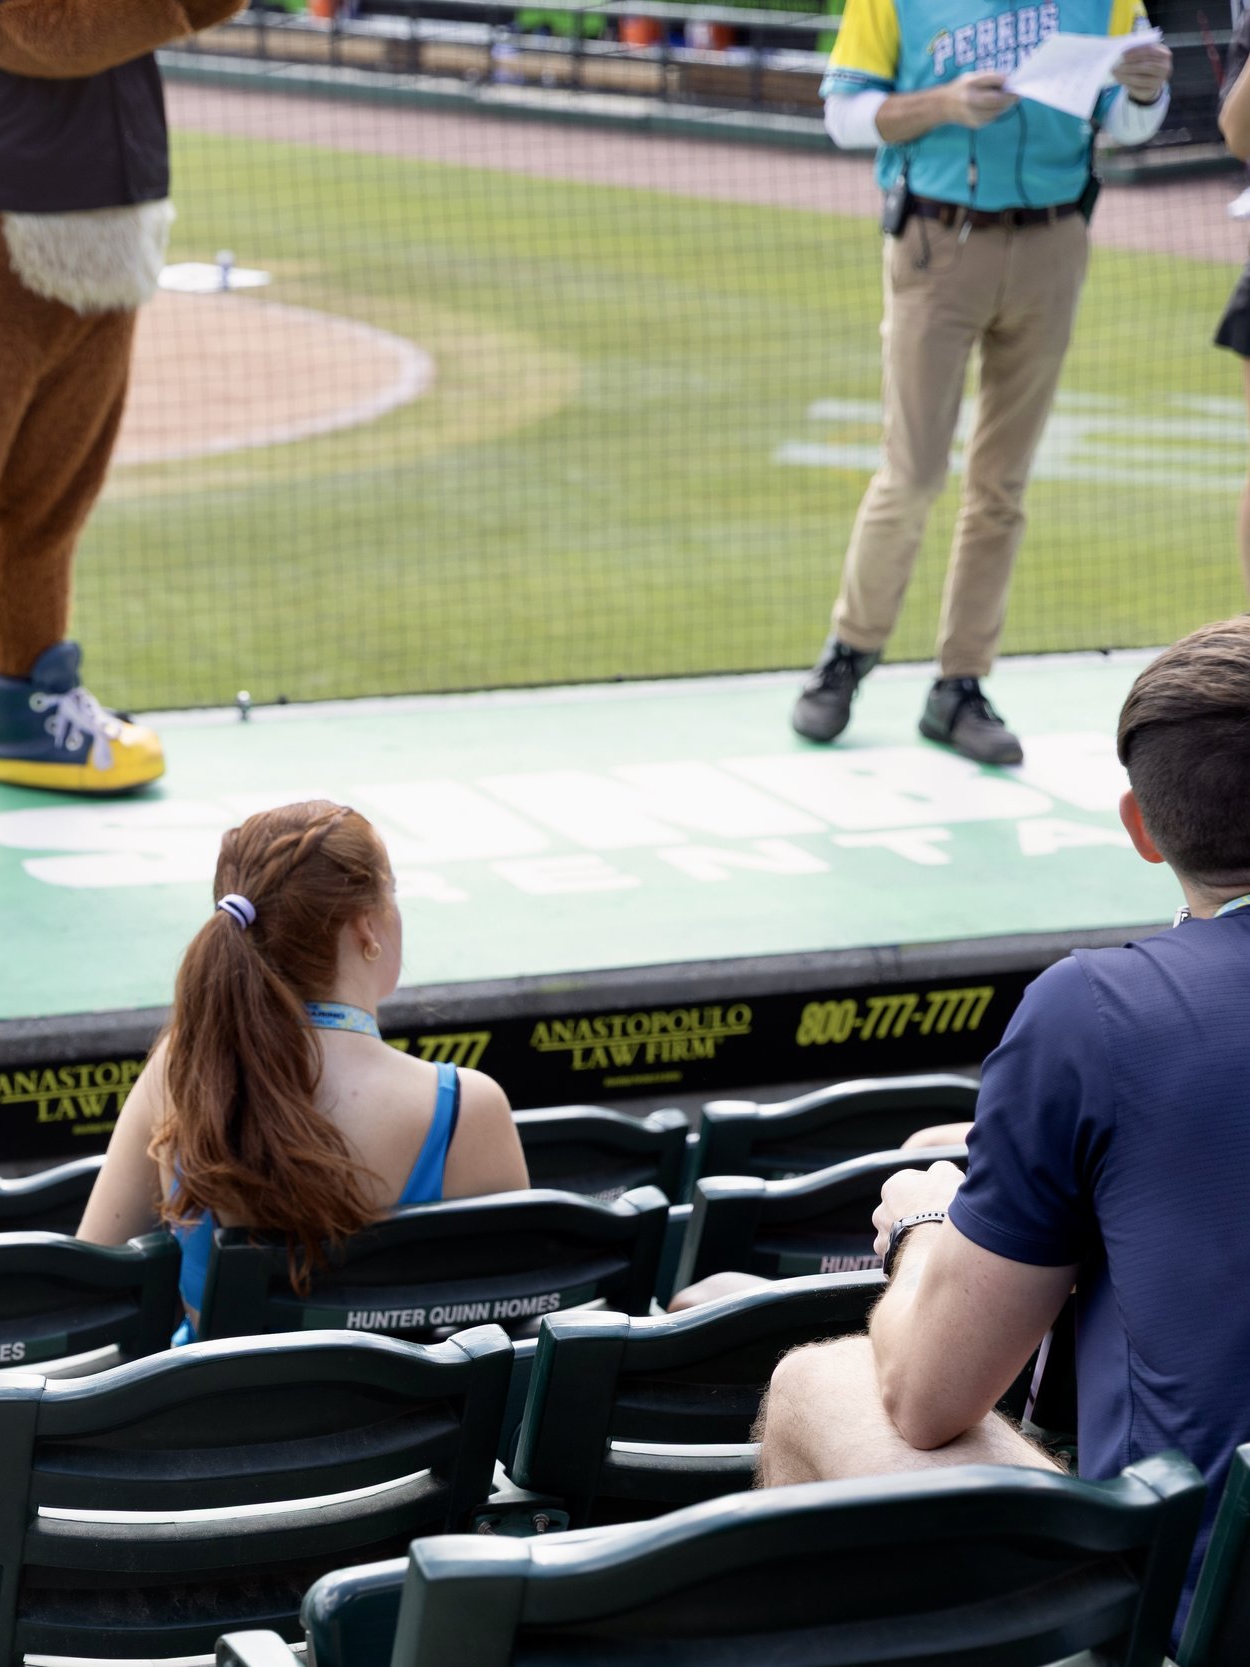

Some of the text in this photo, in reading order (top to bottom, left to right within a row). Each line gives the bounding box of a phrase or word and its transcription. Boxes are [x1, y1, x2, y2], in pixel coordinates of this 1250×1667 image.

[930, 2, 1060, 77] PERROS
[529, 1003, 752, 1047] ANASTOPOULO
[795, 986, 995, 1047] 800-777-7777
[571, 1036, 716, 1071] LAW FIRM
[37, 1093, 109, 1123] LAW
[820, 1255, 885, 1273] HUNTE
[346, 1293, 561, 1329] HUNTER QUINN HOMES
